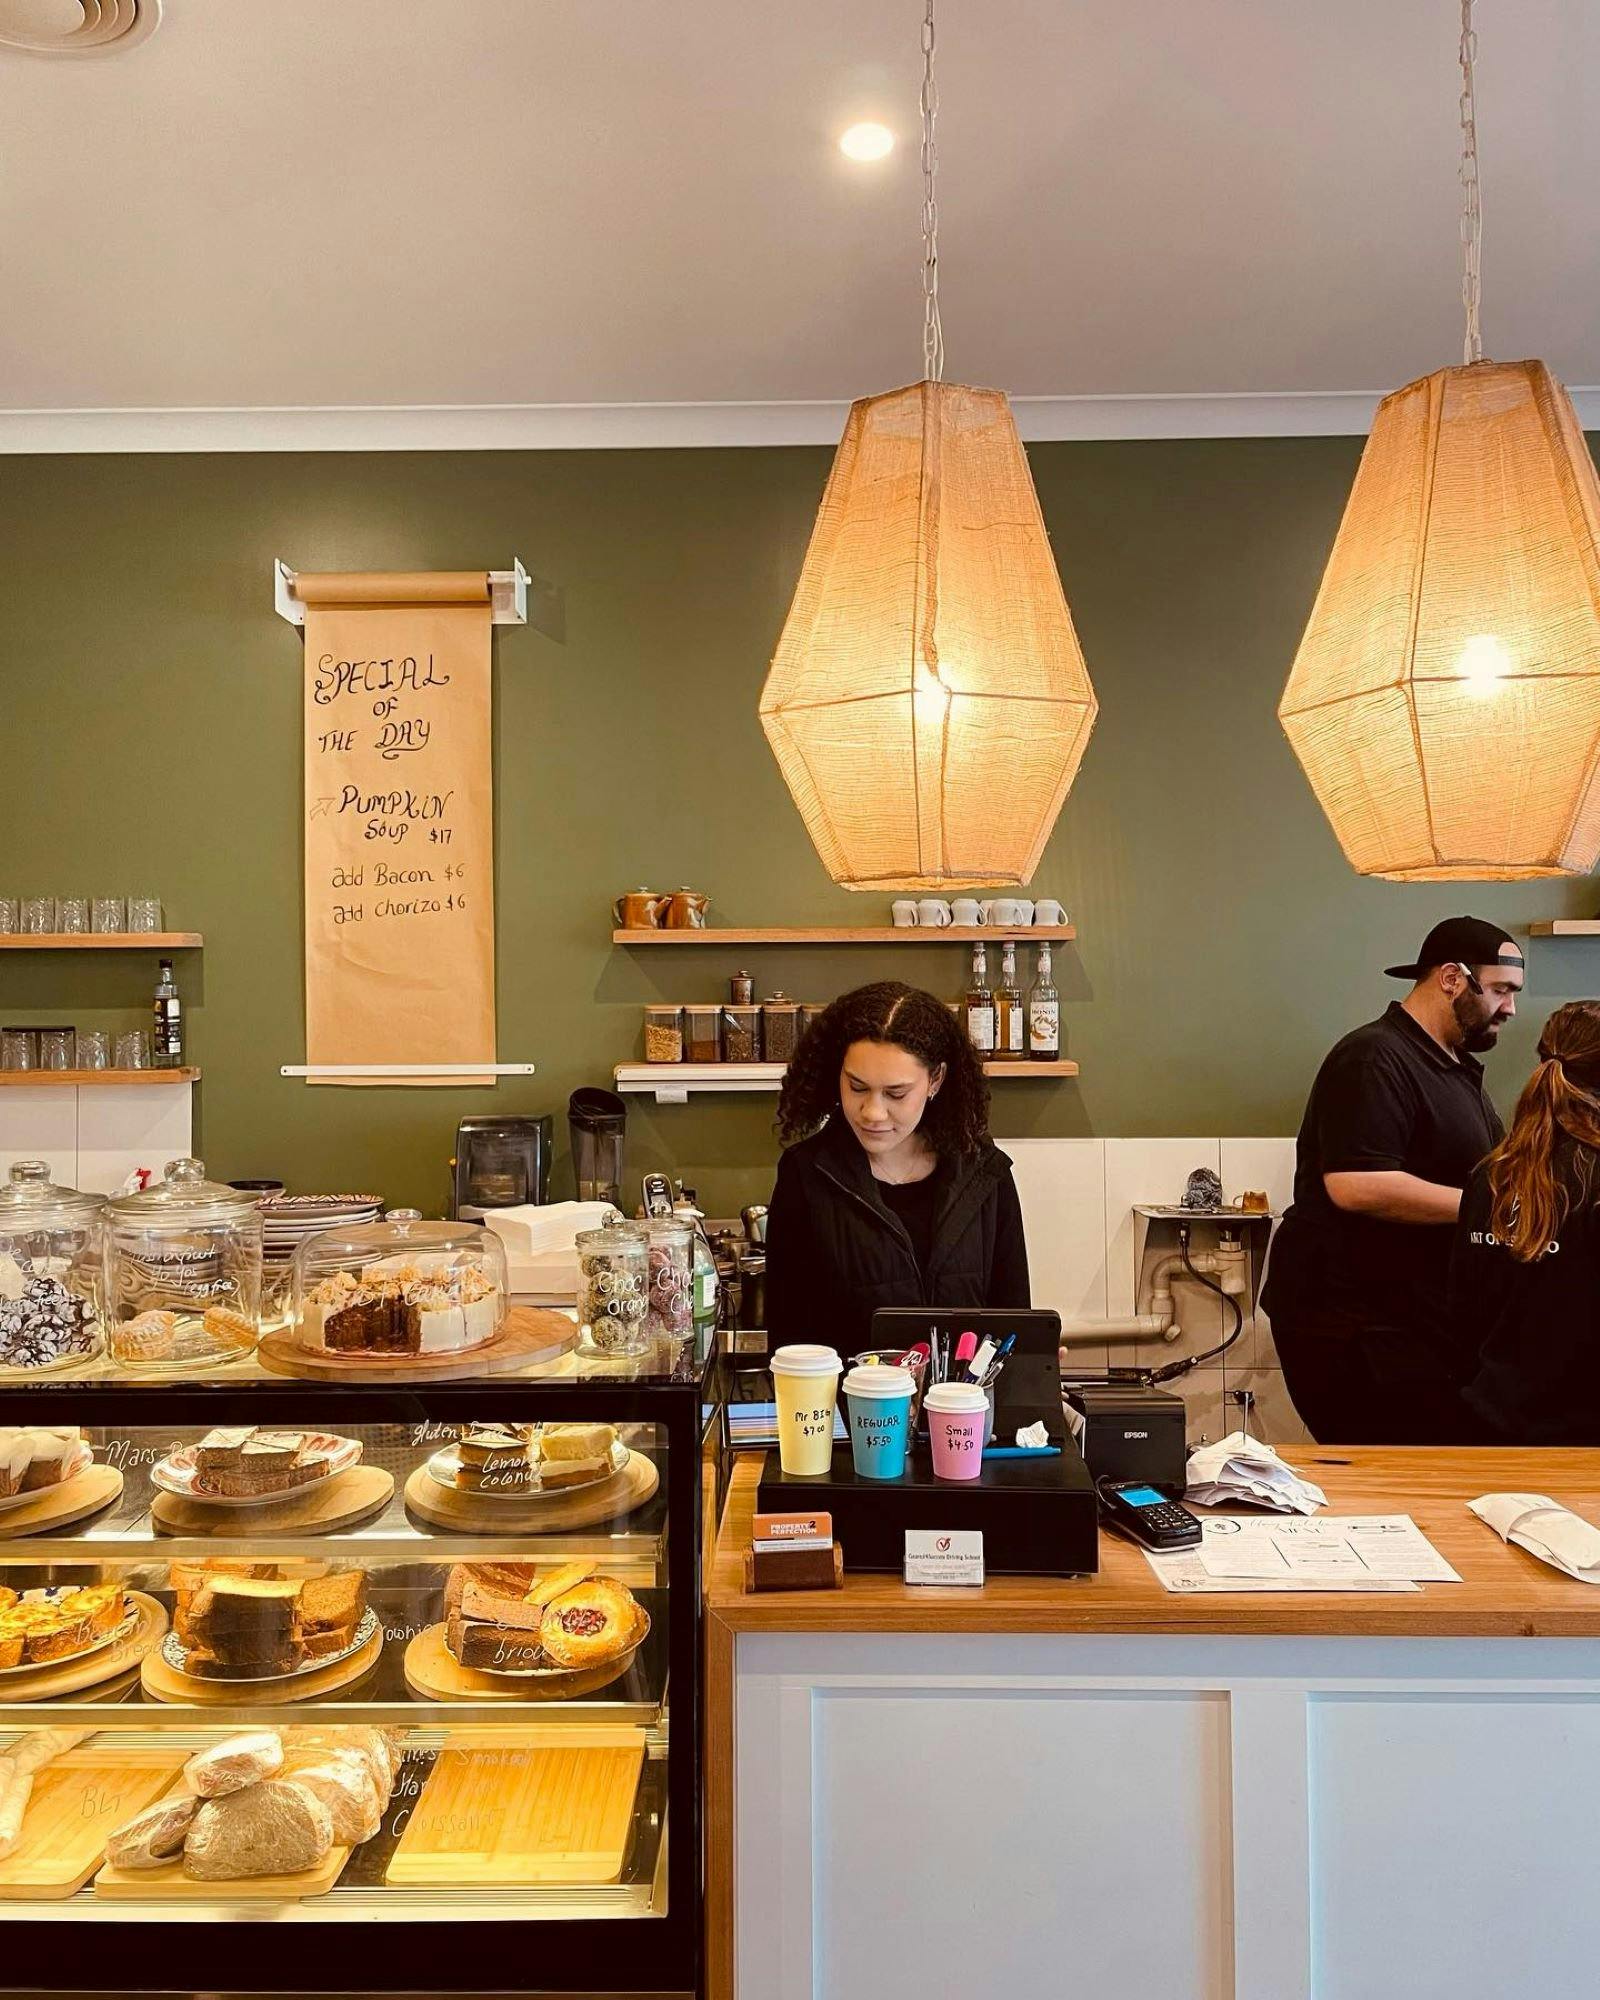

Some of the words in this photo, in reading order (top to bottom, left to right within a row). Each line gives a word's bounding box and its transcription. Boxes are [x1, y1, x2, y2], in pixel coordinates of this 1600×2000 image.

[314, 654, 450, 704] SPECIAL
[372, 697, 398, 720] OF
[318, 730, 358, 753] THE
[375, 719, 431, 760] DAY
[429, 828, 452, 844] $17
[331, 865, 363, 887] add
[374, 863, 435, 886] Bacon
[445, 862, 465, 880] $6
[333, 904, 363, 924] add
[446, 893, 466, 911] $6
[795, 1411, 808, 1422] Mr
[857, 1415, 900, 1429] REGULAR
[946, 1425, 973, 1437] Small
